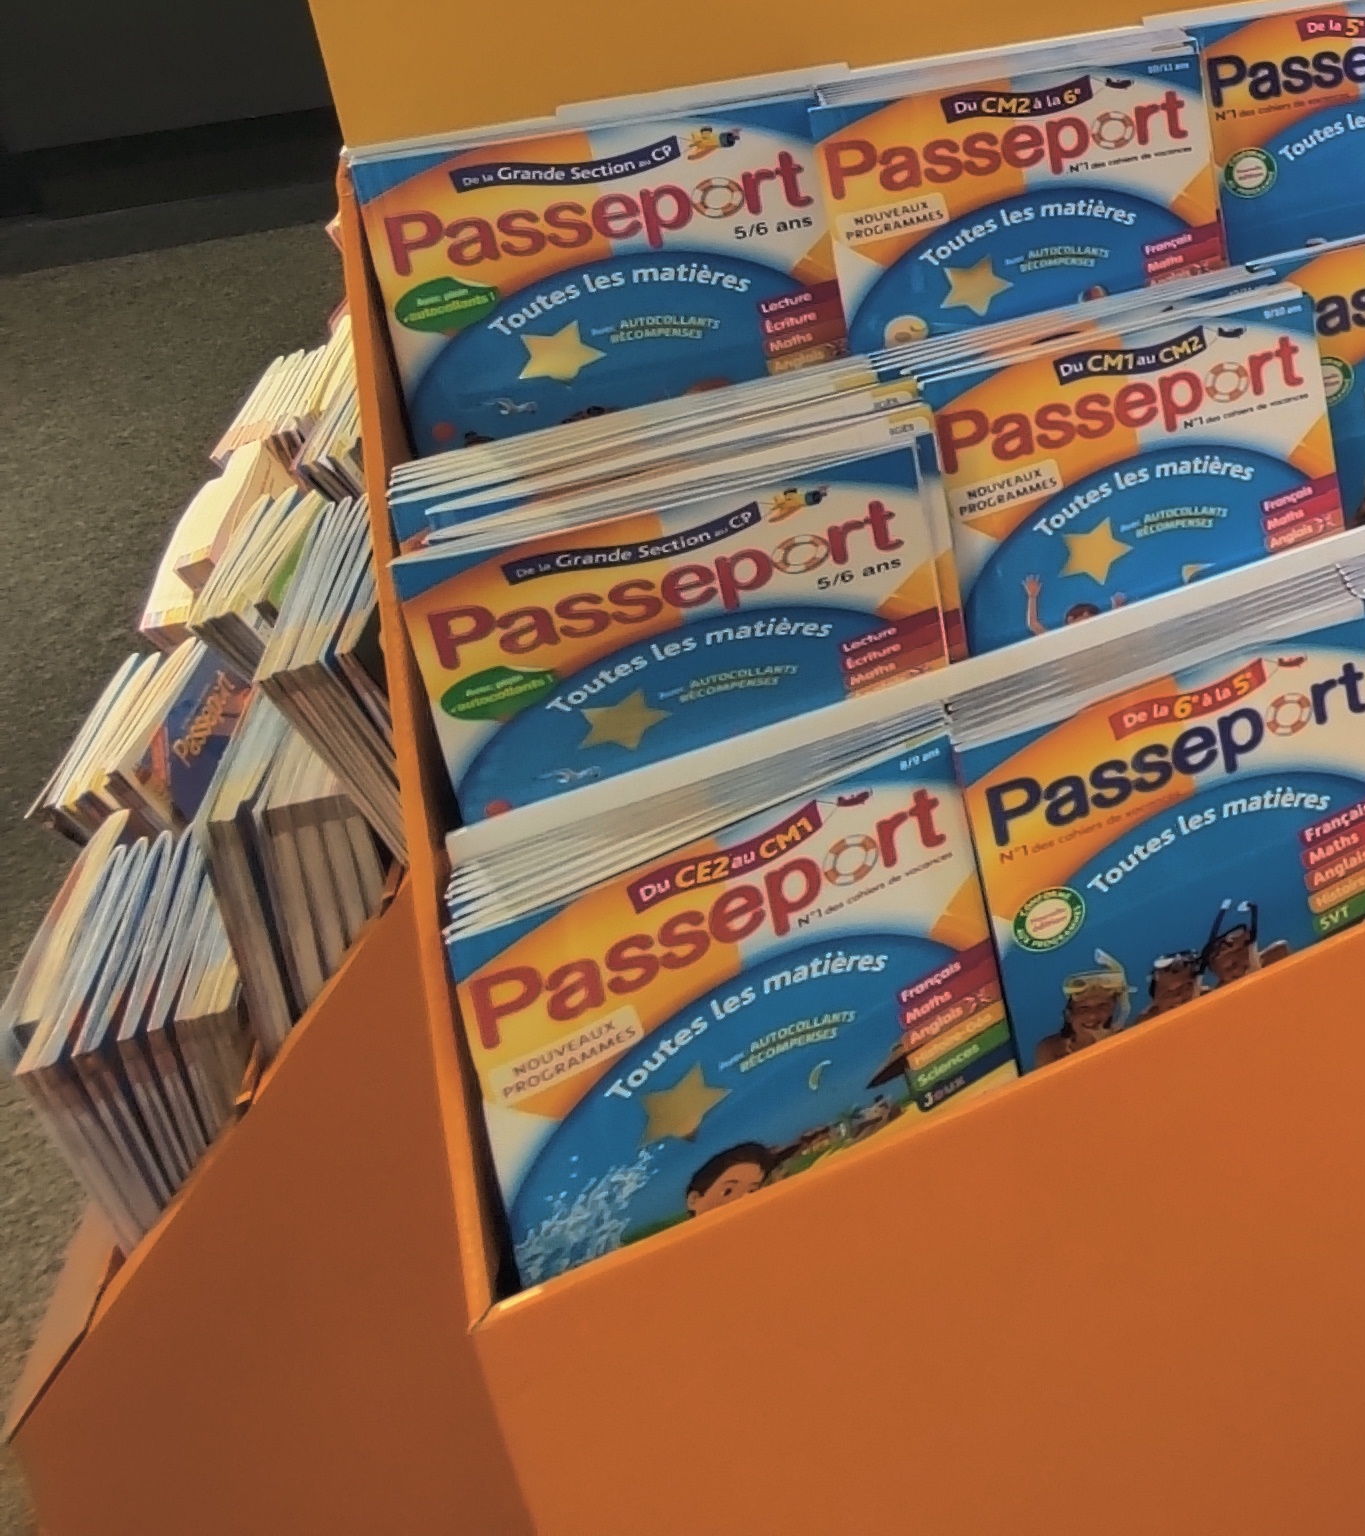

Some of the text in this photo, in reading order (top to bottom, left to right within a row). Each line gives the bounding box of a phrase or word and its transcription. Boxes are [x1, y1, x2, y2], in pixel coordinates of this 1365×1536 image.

[823, 89, 1189, 201] Passeport
[383, 152, 815, 276] Passeport
[488, 262, 752, 340] Toutes les matières
[935, 336, 1305, 475] Passeport
[427, 500, 904, 671] Passeport
[1087, 788, 1331, 894] Toutes les matières
[1308, 831, 1360, 864] Maths
[468, 787, 947, 1052] Passeport
